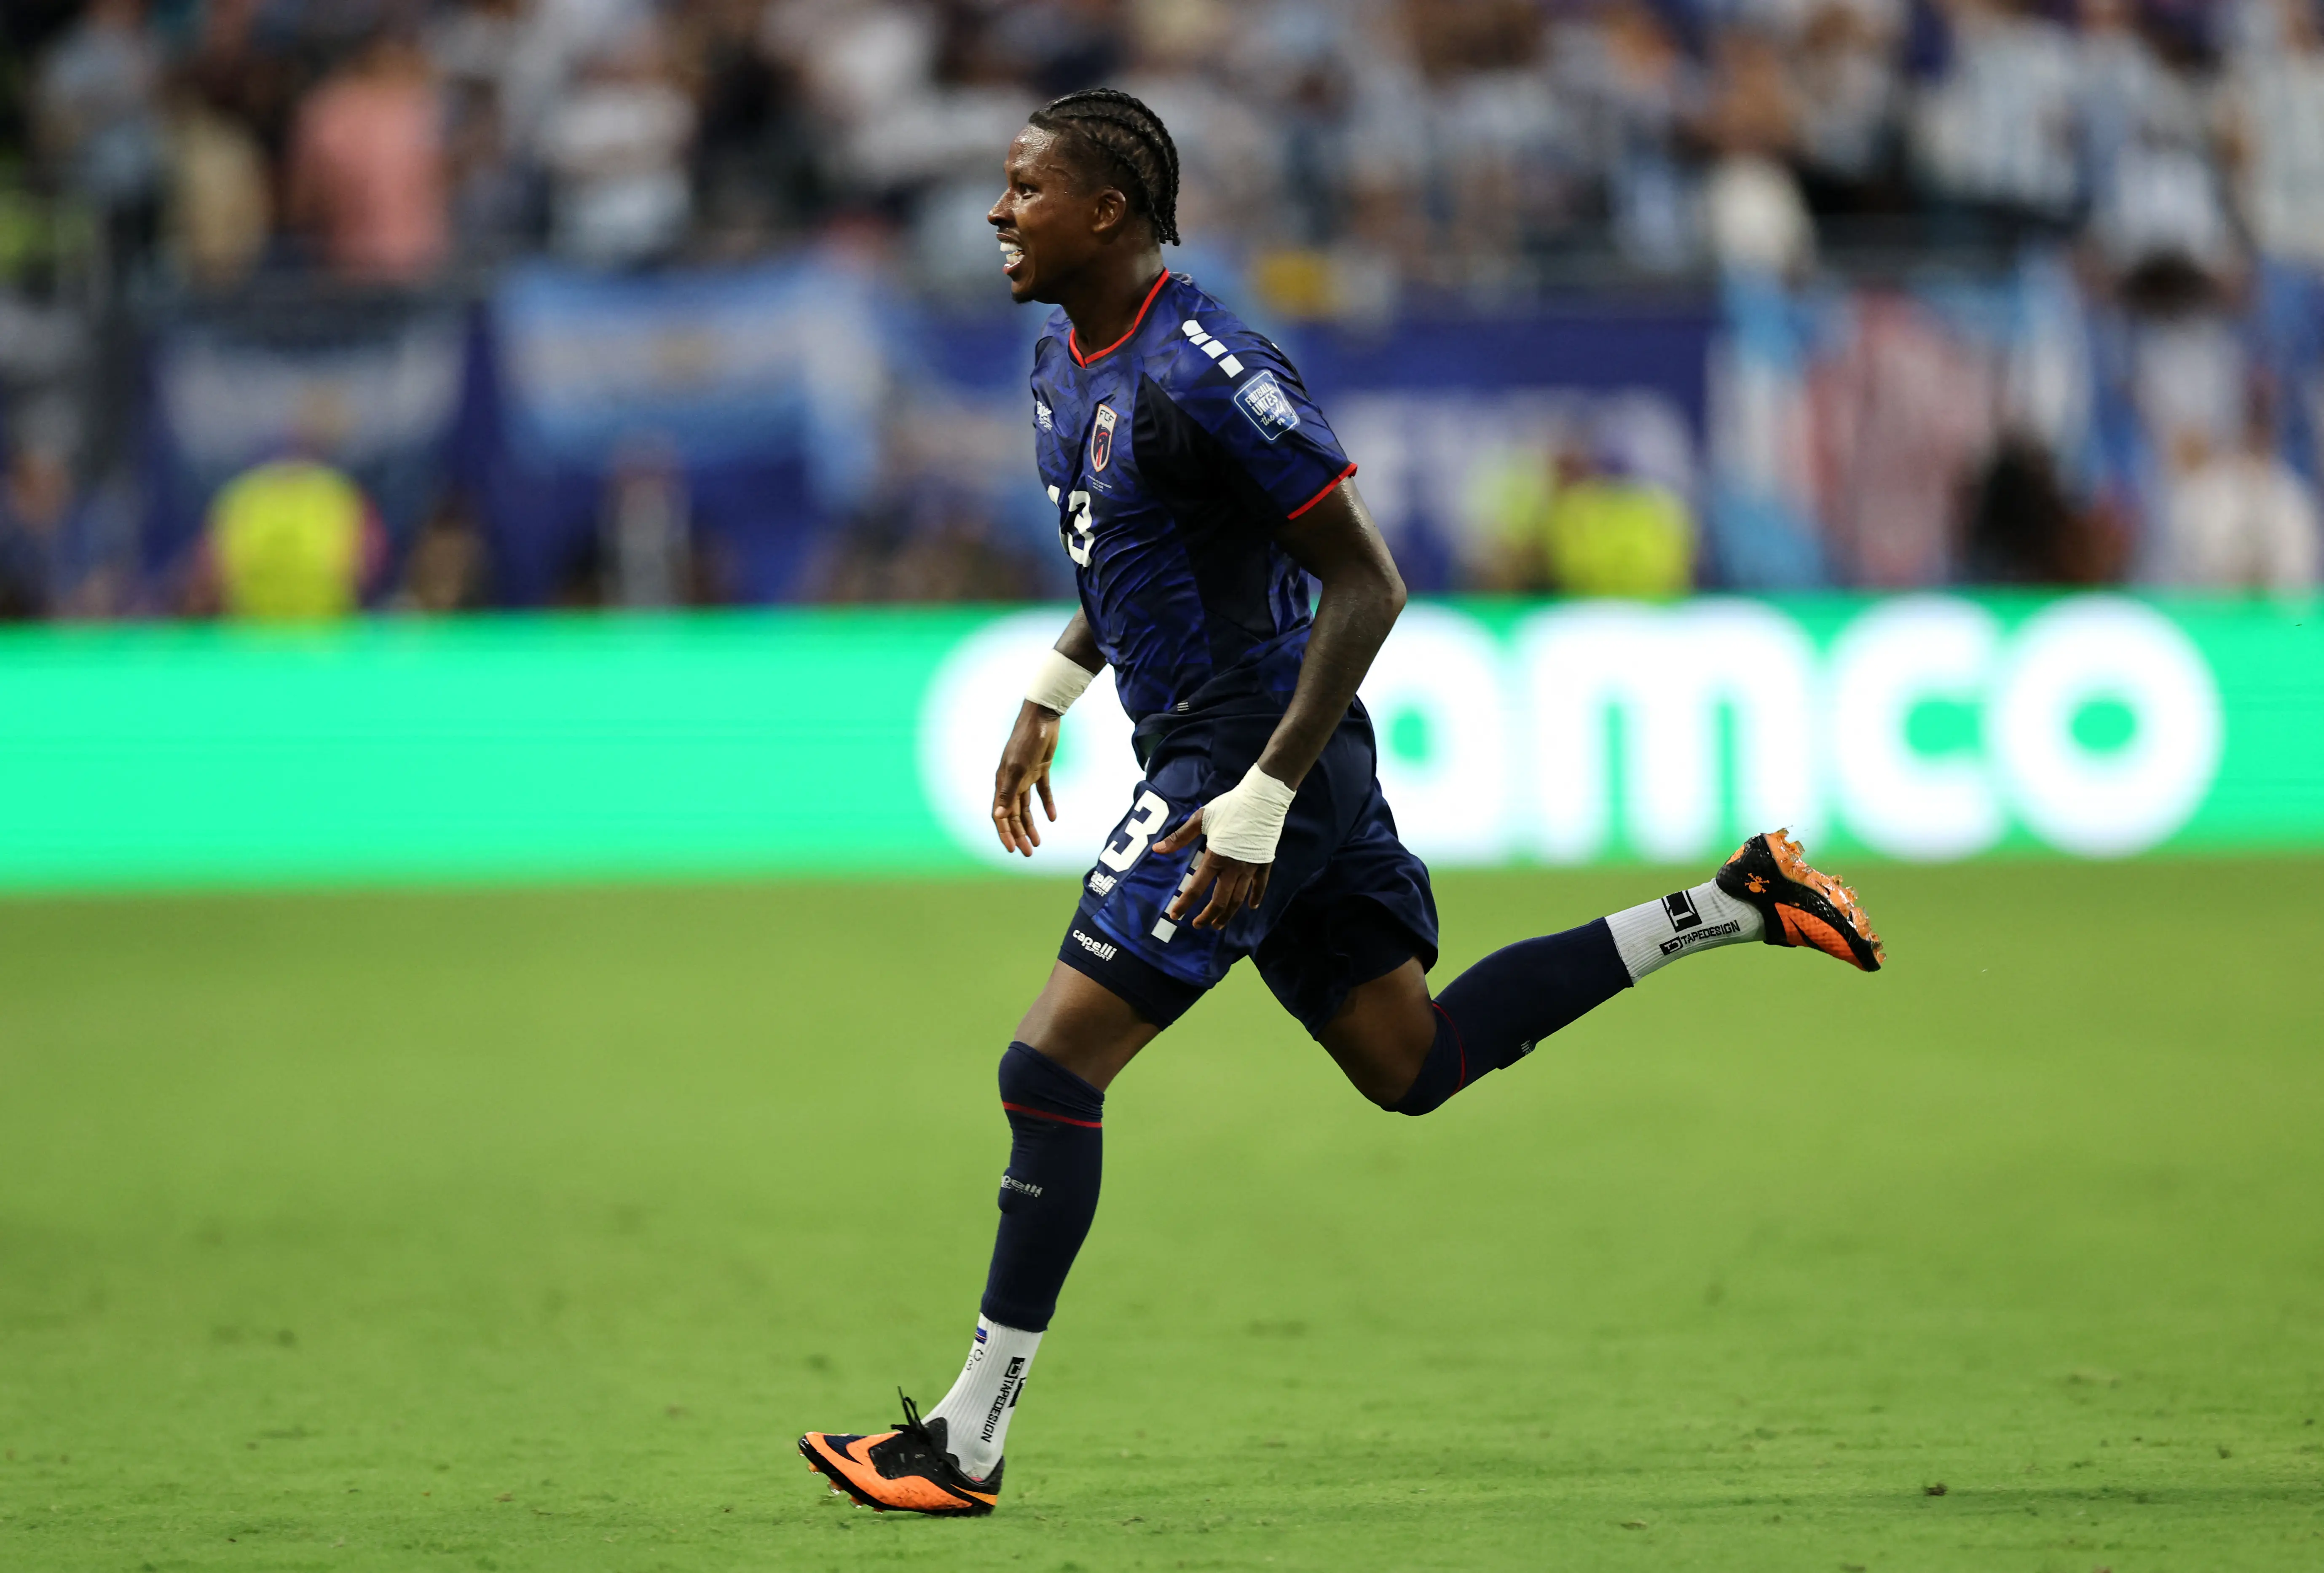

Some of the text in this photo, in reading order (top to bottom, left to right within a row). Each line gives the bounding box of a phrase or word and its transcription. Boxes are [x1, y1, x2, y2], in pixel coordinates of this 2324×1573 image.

[1099, 409, 1114, 423] FCF
[1260, 415, 1275, 426] the
[1099, 790, 1169, 872] 3
[1072, 929, 1118, 958] capelli
[1681, 920, 1740, 944] TAPEDESIGN
[1084, 945, 1111, 961] SPORT
[981, 1379, 1015, 1443] TAPEDESIGN
